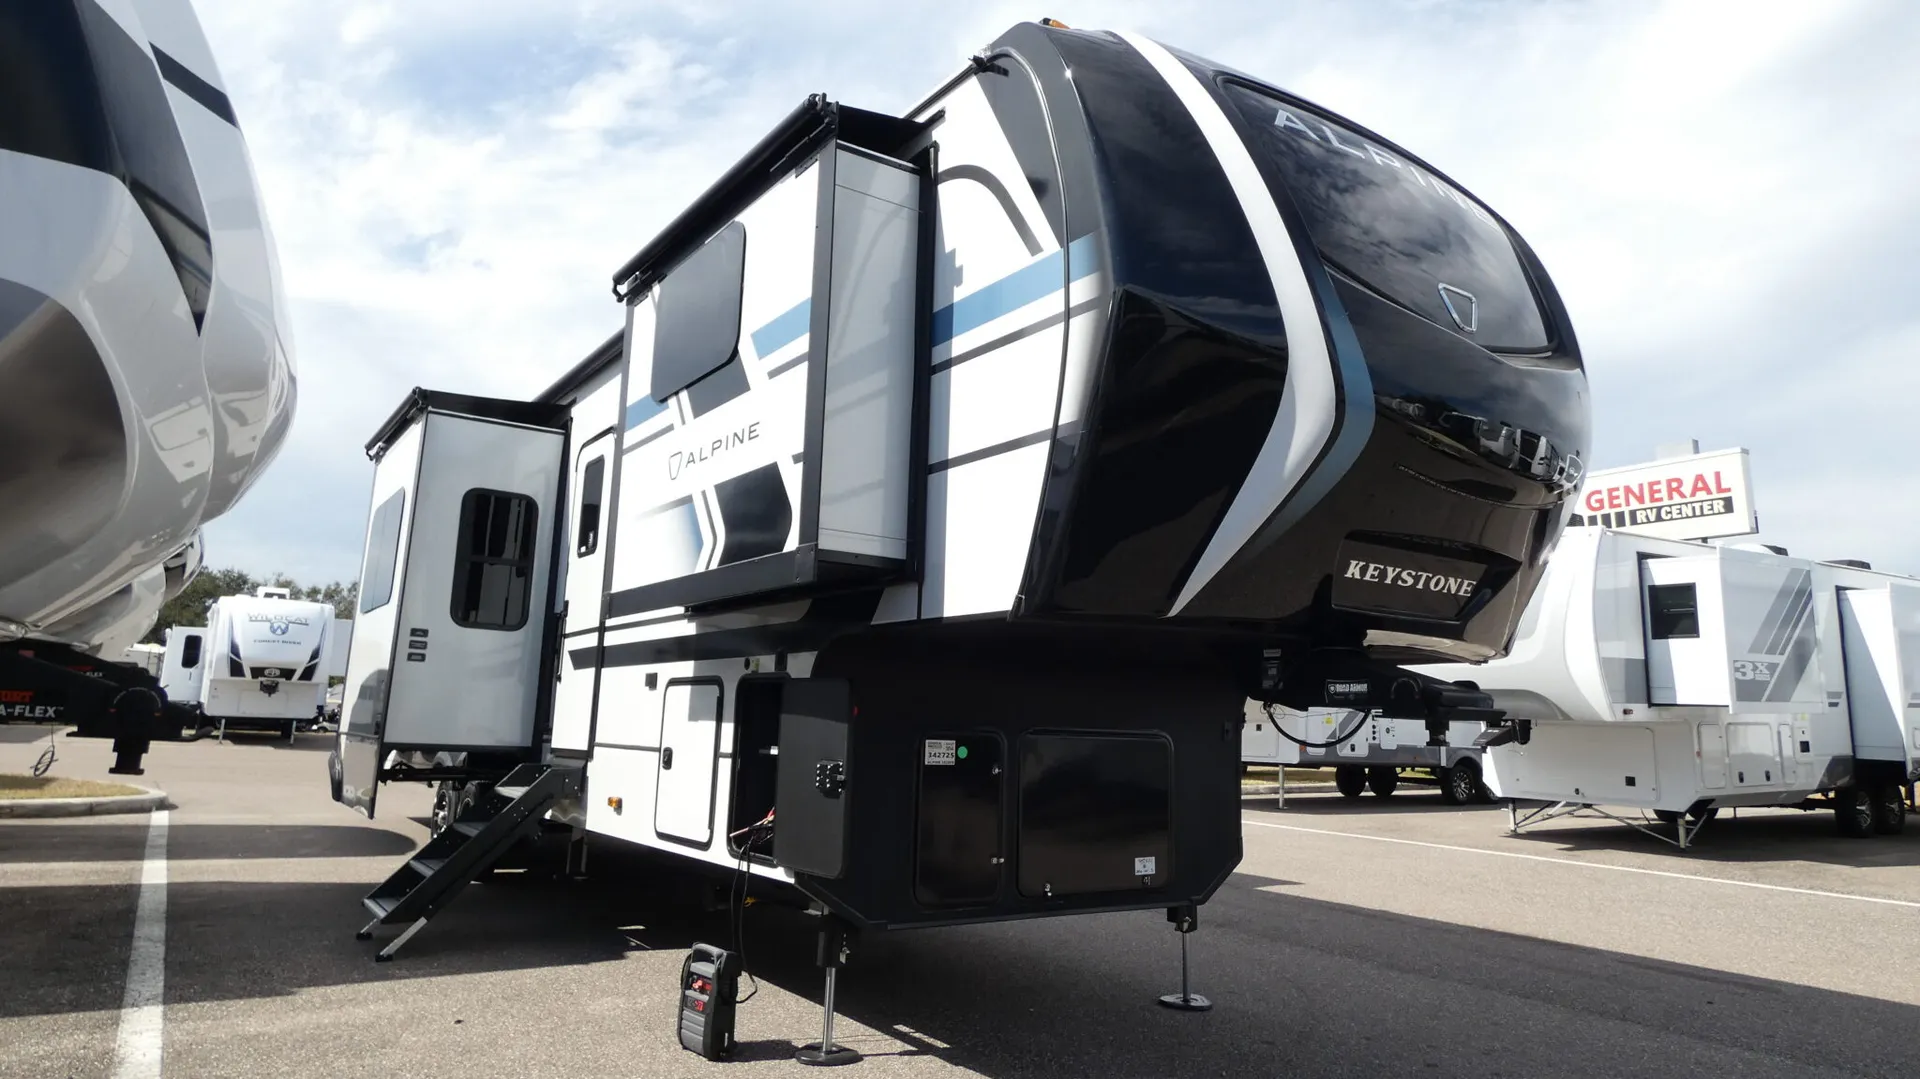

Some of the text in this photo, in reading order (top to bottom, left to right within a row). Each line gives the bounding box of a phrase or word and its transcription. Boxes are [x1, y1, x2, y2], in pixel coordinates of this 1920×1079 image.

[1274, 109, 1501, 232] ALPINE
[685, 421, 760, 468] ALPINE
[1585, 471, 1732, 512] GENERAL
[1636, 499, 1726, 524] RV CENTER
[1344, 560, 1477, 597] KEYSTONE
[247, 613, 308, 625] WILDCAT
